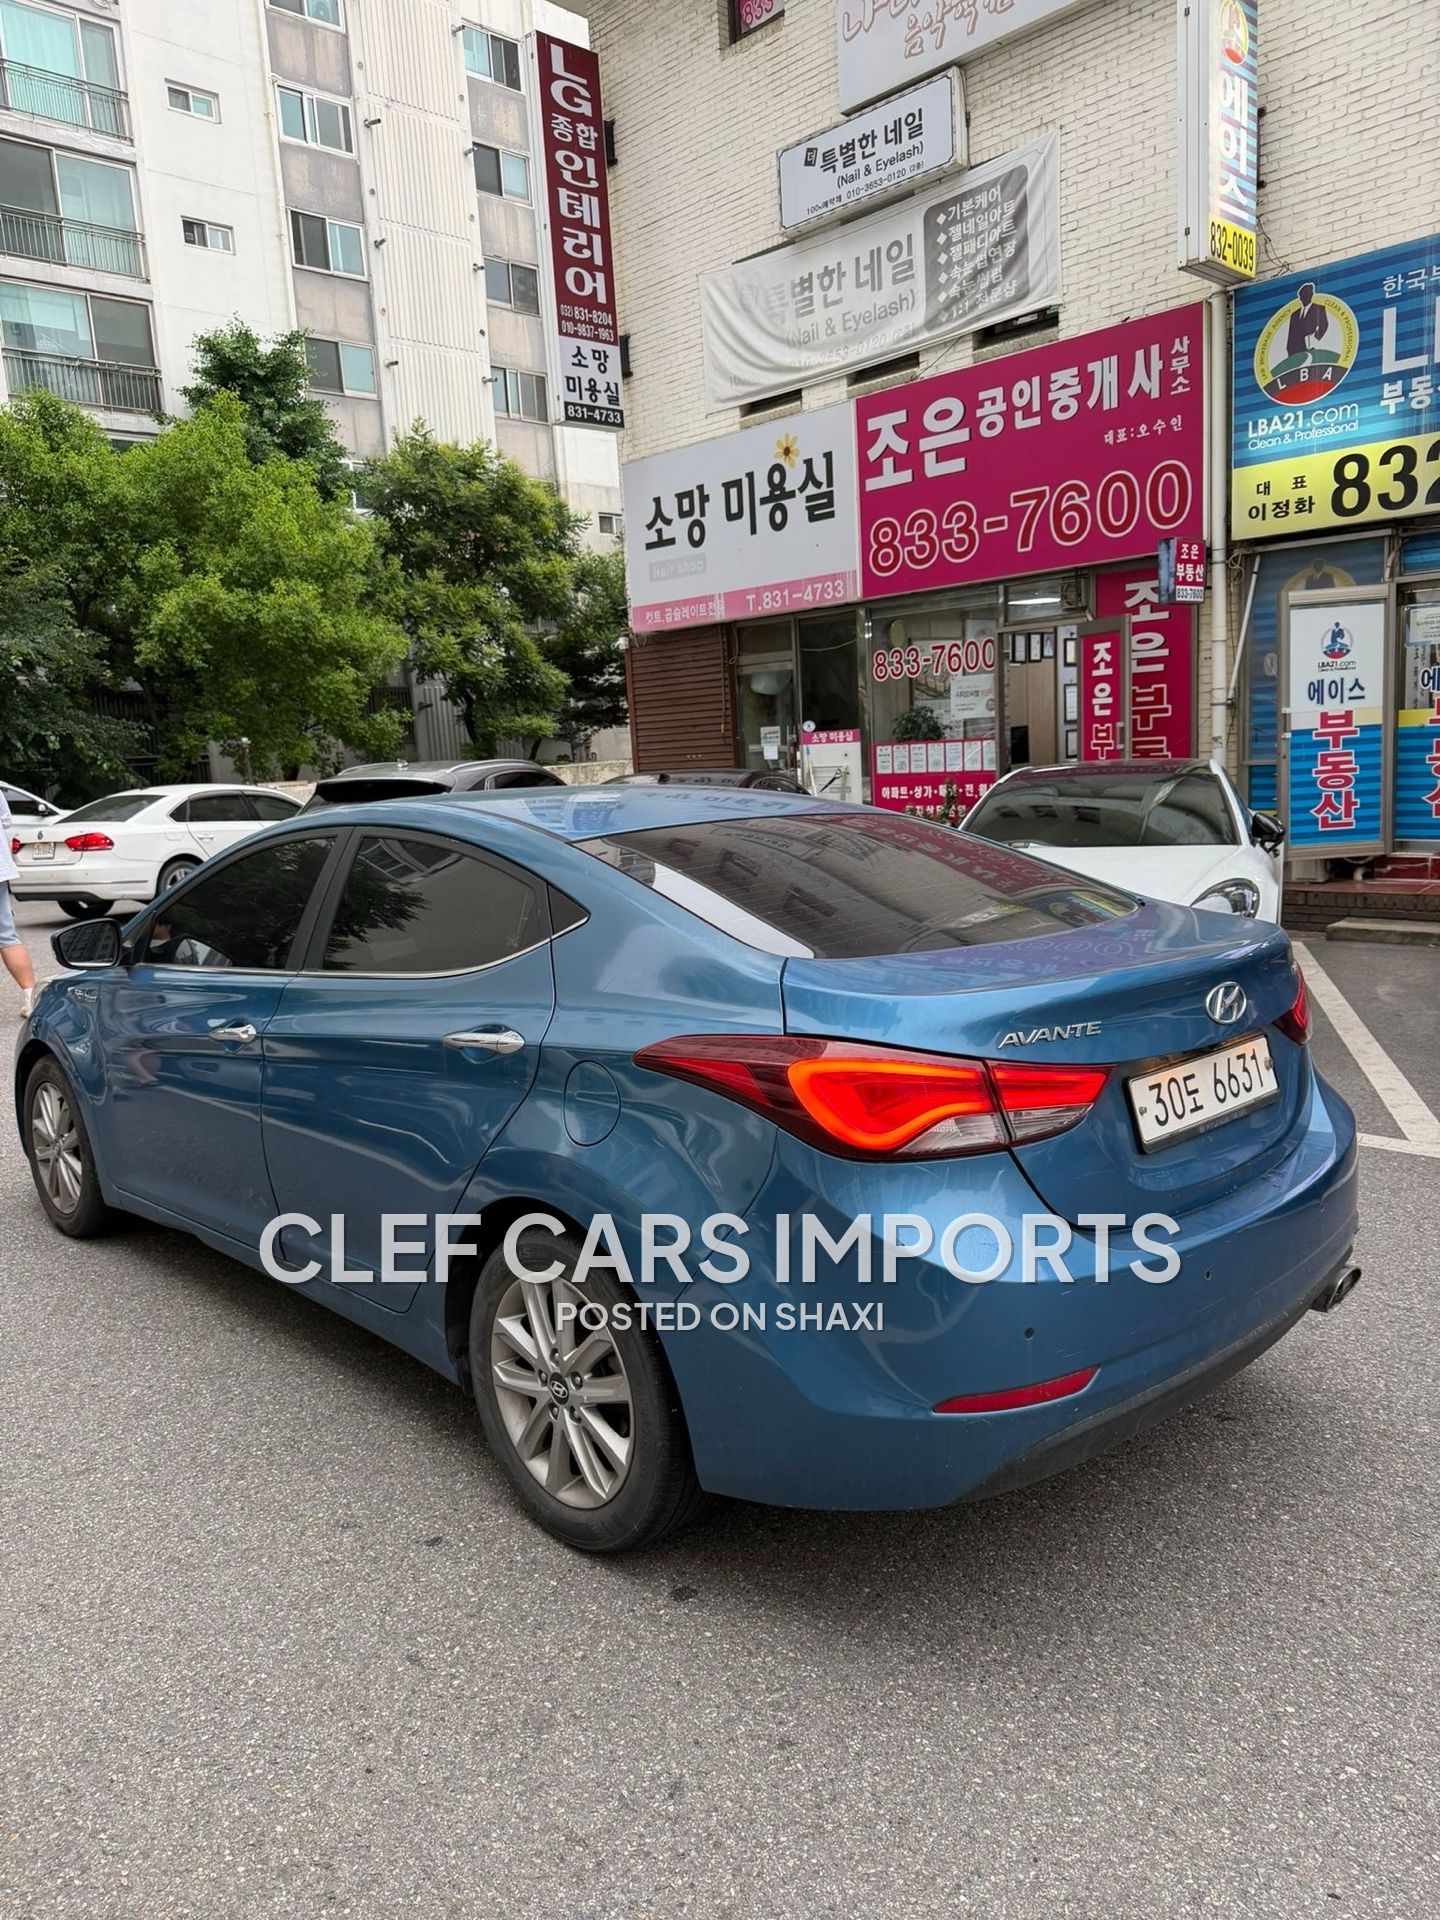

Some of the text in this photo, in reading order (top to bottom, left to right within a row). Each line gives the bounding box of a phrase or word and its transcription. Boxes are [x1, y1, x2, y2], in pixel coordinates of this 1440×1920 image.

[549, 43, 592, 118] LG
[551, 113, 597, 152] 종합
[820, 129, 878, 173] 특별한
[884, 108, 924, 145] 네일
[1218, 74, 1249, 222] 에이스
[837, 141, 924, 189] (Nail & Eyelash)
[948, 184, 1001, 221] 기본케어
[554, 148, 607, 305] 인테리어
[1210, 221, 1254, 272] 832-0039
[854, 233, 916, 292] 네일
[825, 316, 838, 337] &
[842, 288, 917, 332] Eyelash)
[1382, 295, 1440, 376] L
[571, 346, 609, 374] 소망
[565, 376, 620, 407] 미용실
[1380, 373, 1440, 416] 부동
[567, 405, 621, 424] 831-4733
[865, 335, 1191, 493] 조은 공인중개사 사무소
[1248, 403, 1359, 439] LBA21.com
[1248, 419, 1359, 451] Clean & Professional
[645, 450, 836, 551] 소망 미용실
[869, 460, 1192, 578] 833-7600
[1248, 496, 1316, 521] 이정화
[1176, 563, 1203, 582] 부동산
[1181, 544, 1199, 560] 조은
[746, 579, 845, 612] T.831-4733
[873, 638, 995, 682] 833-7600
[1307, 677, 1365, 706] 에이스
[829, 730, 853, 742] 미용실
[1311, 709, 1360, 831] 부동산
[998, 1021, 1101, 1050] AVANTE
[1148, 1072, 1204, 1127] 30도
[1213, 1048, 1264, 1104] 6631
